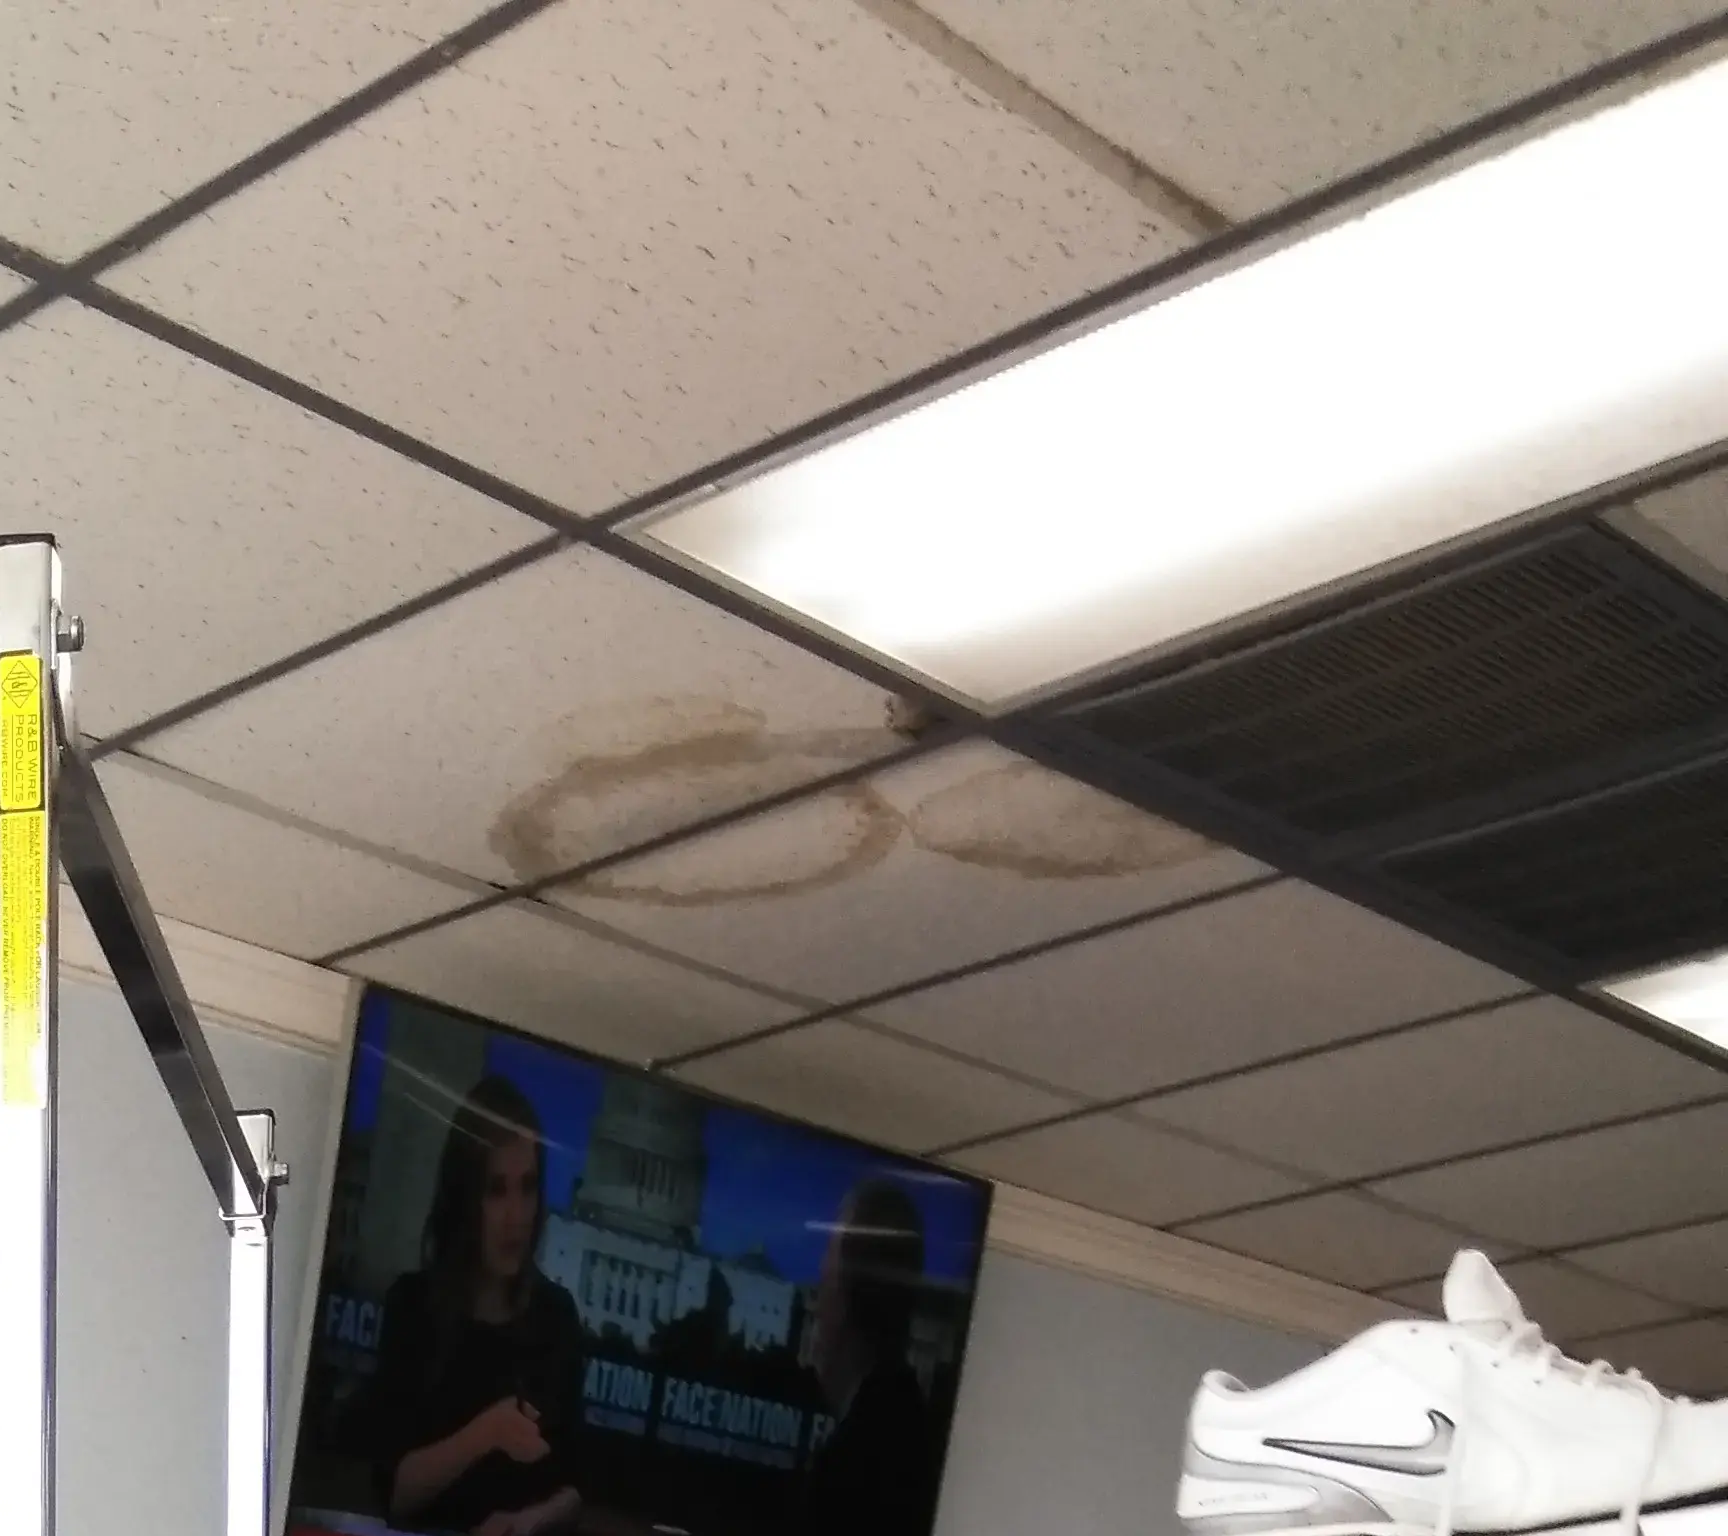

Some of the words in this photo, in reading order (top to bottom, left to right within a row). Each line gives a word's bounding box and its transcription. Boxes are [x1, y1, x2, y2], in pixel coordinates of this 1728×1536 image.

[14, 713, 25, 803] PRODUCTS
[27, 713, 39, 753] R&B
[27, 757, 39, 801] WIRE
[582, 1356, 655, 1412] ATION
